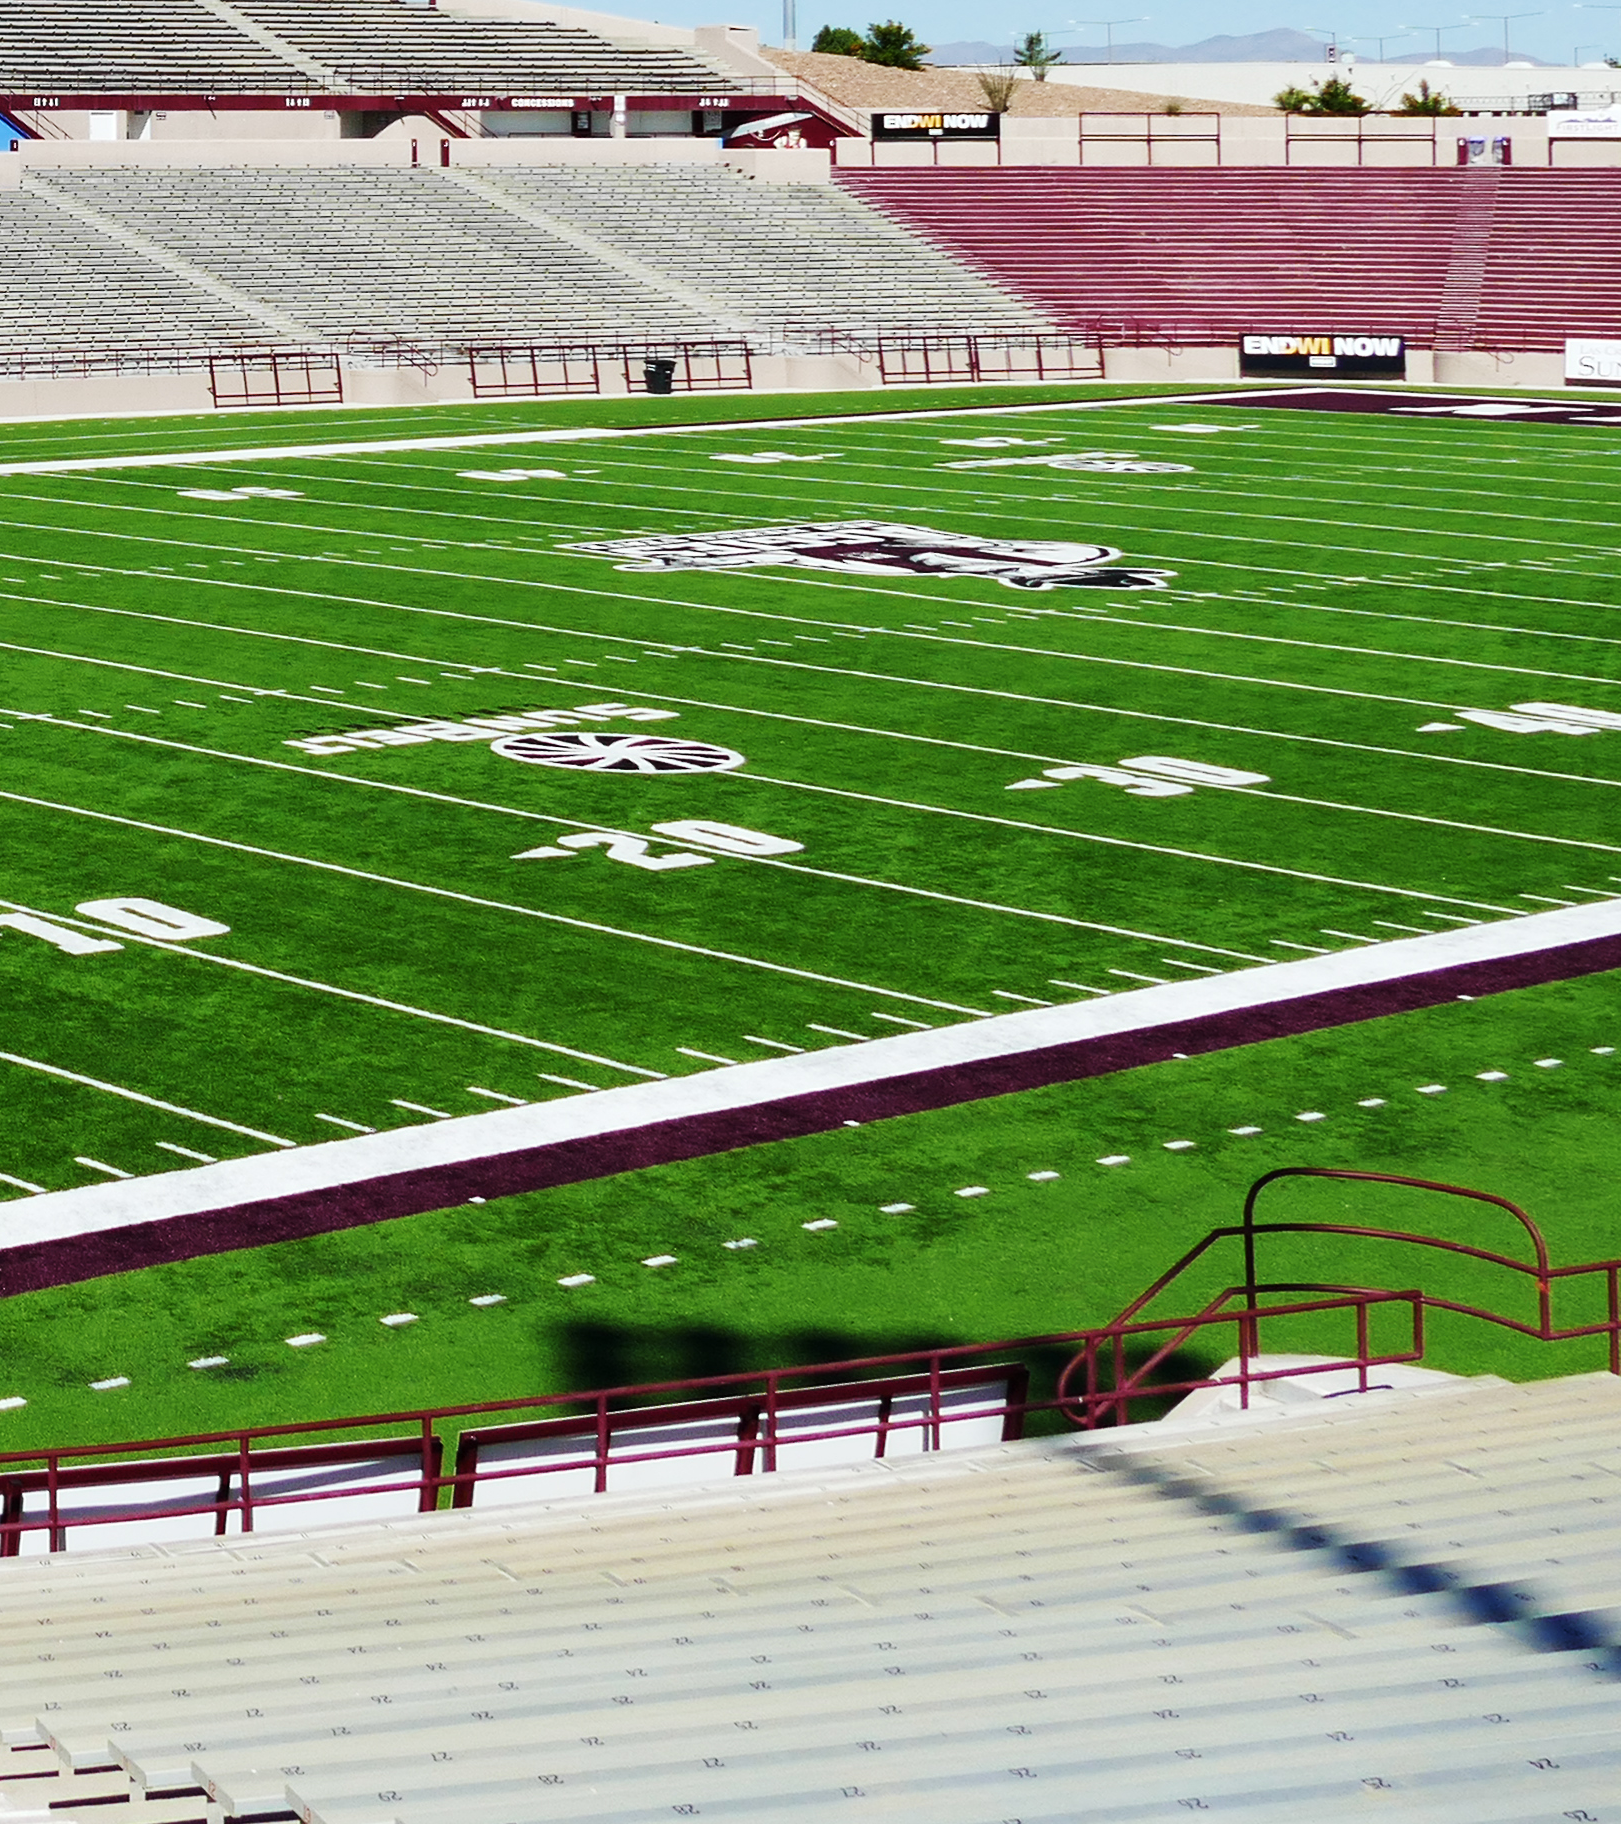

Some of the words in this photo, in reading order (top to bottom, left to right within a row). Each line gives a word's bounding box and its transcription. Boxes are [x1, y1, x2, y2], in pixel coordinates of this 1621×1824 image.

[943, 114, 988, 128] NOW
[1333, 337, 1400, 357] NOW
[1041, 755, 1272, 797] 30
[555, 819, 805, 871] 20
